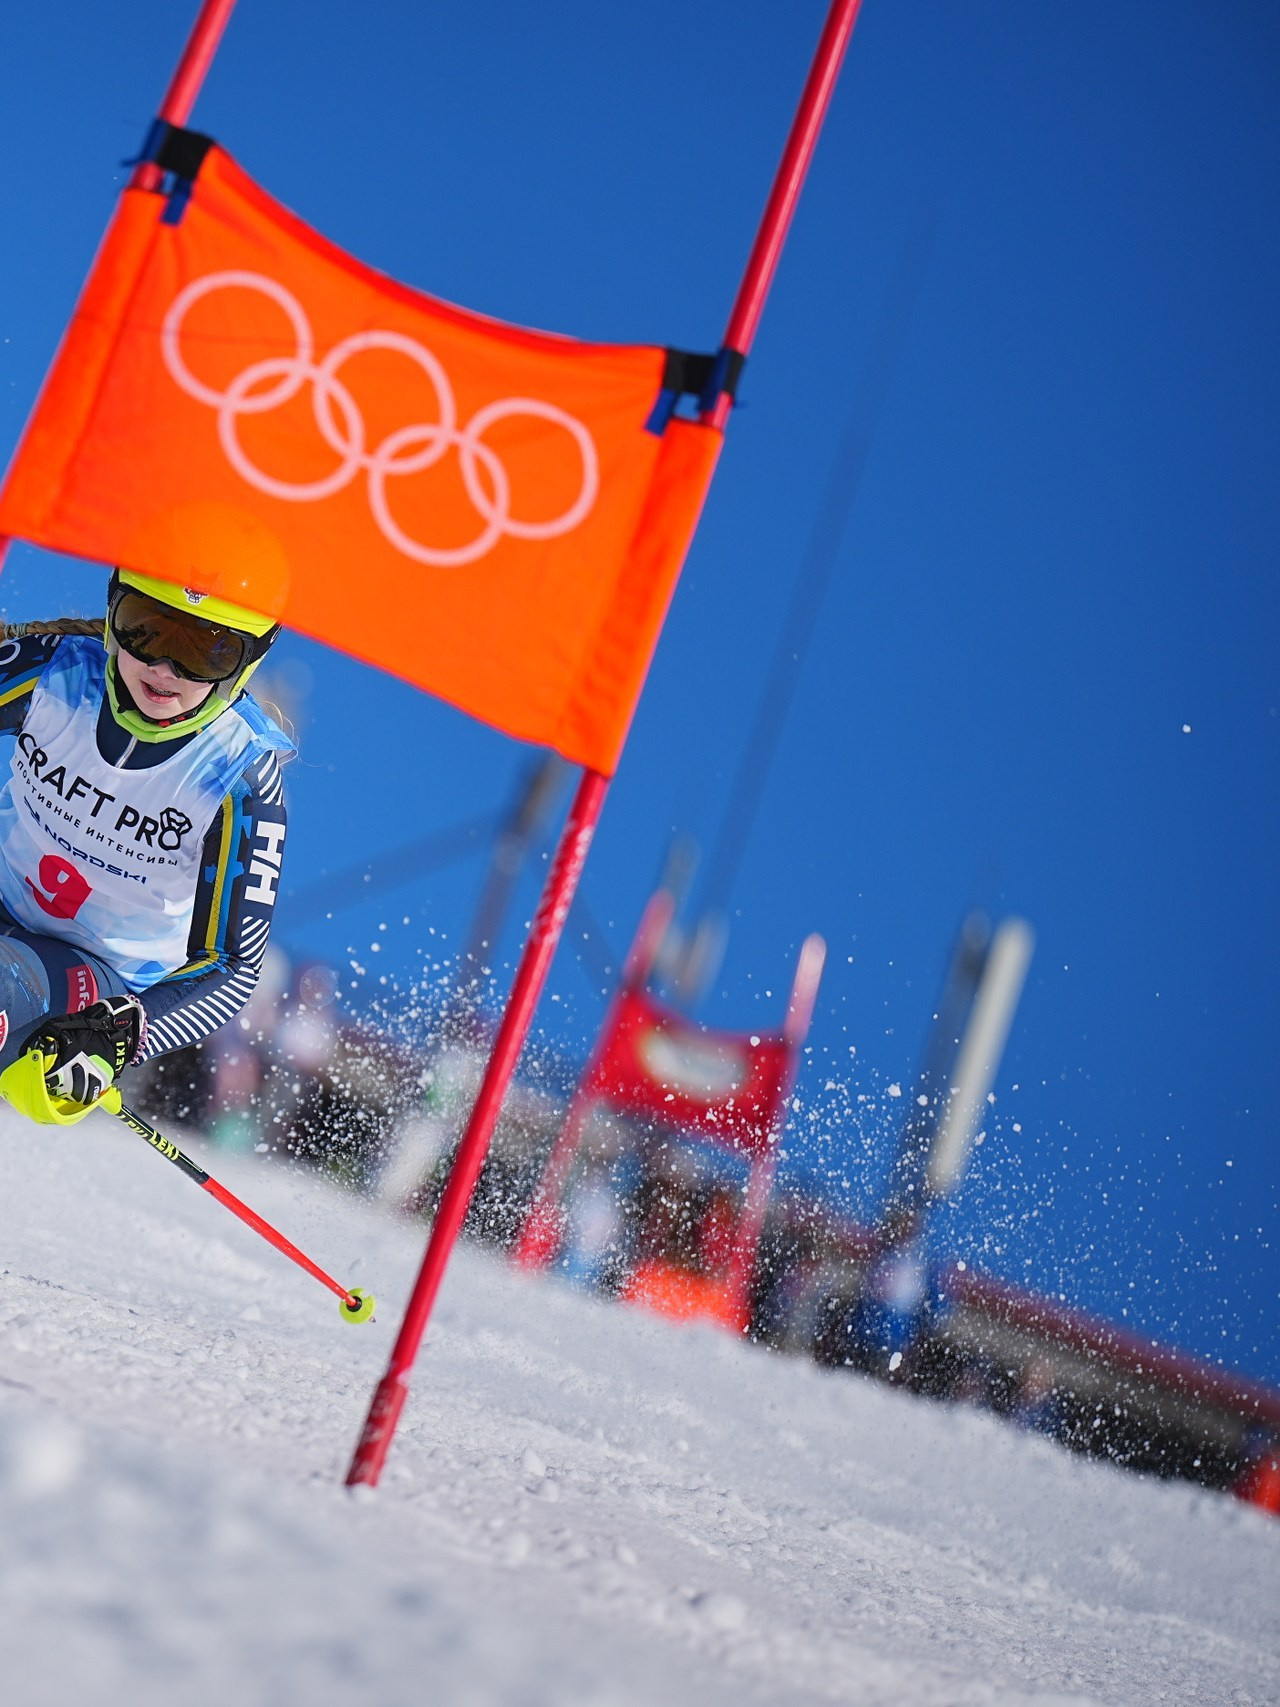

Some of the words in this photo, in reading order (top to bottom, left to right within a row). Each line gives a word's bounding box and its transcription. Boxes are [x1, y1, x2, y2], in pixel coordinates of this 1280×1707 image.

[15, 755, 81, 829] ПОРТИВНЫЕ
[85, 826, 178, 867] ИНТЕНСИВЫ
[18, 733, 115, 817] CRAFT
[114, 805, 192, 851] PRO
[24, 854, 93, 920] 9
[44, 825, 147, 885] NORDSKI
[243, 820, 286, 906] HH
[115, 1041, 126, 1072] LEKI
[148, 1130, 180, 1161] LEKI
